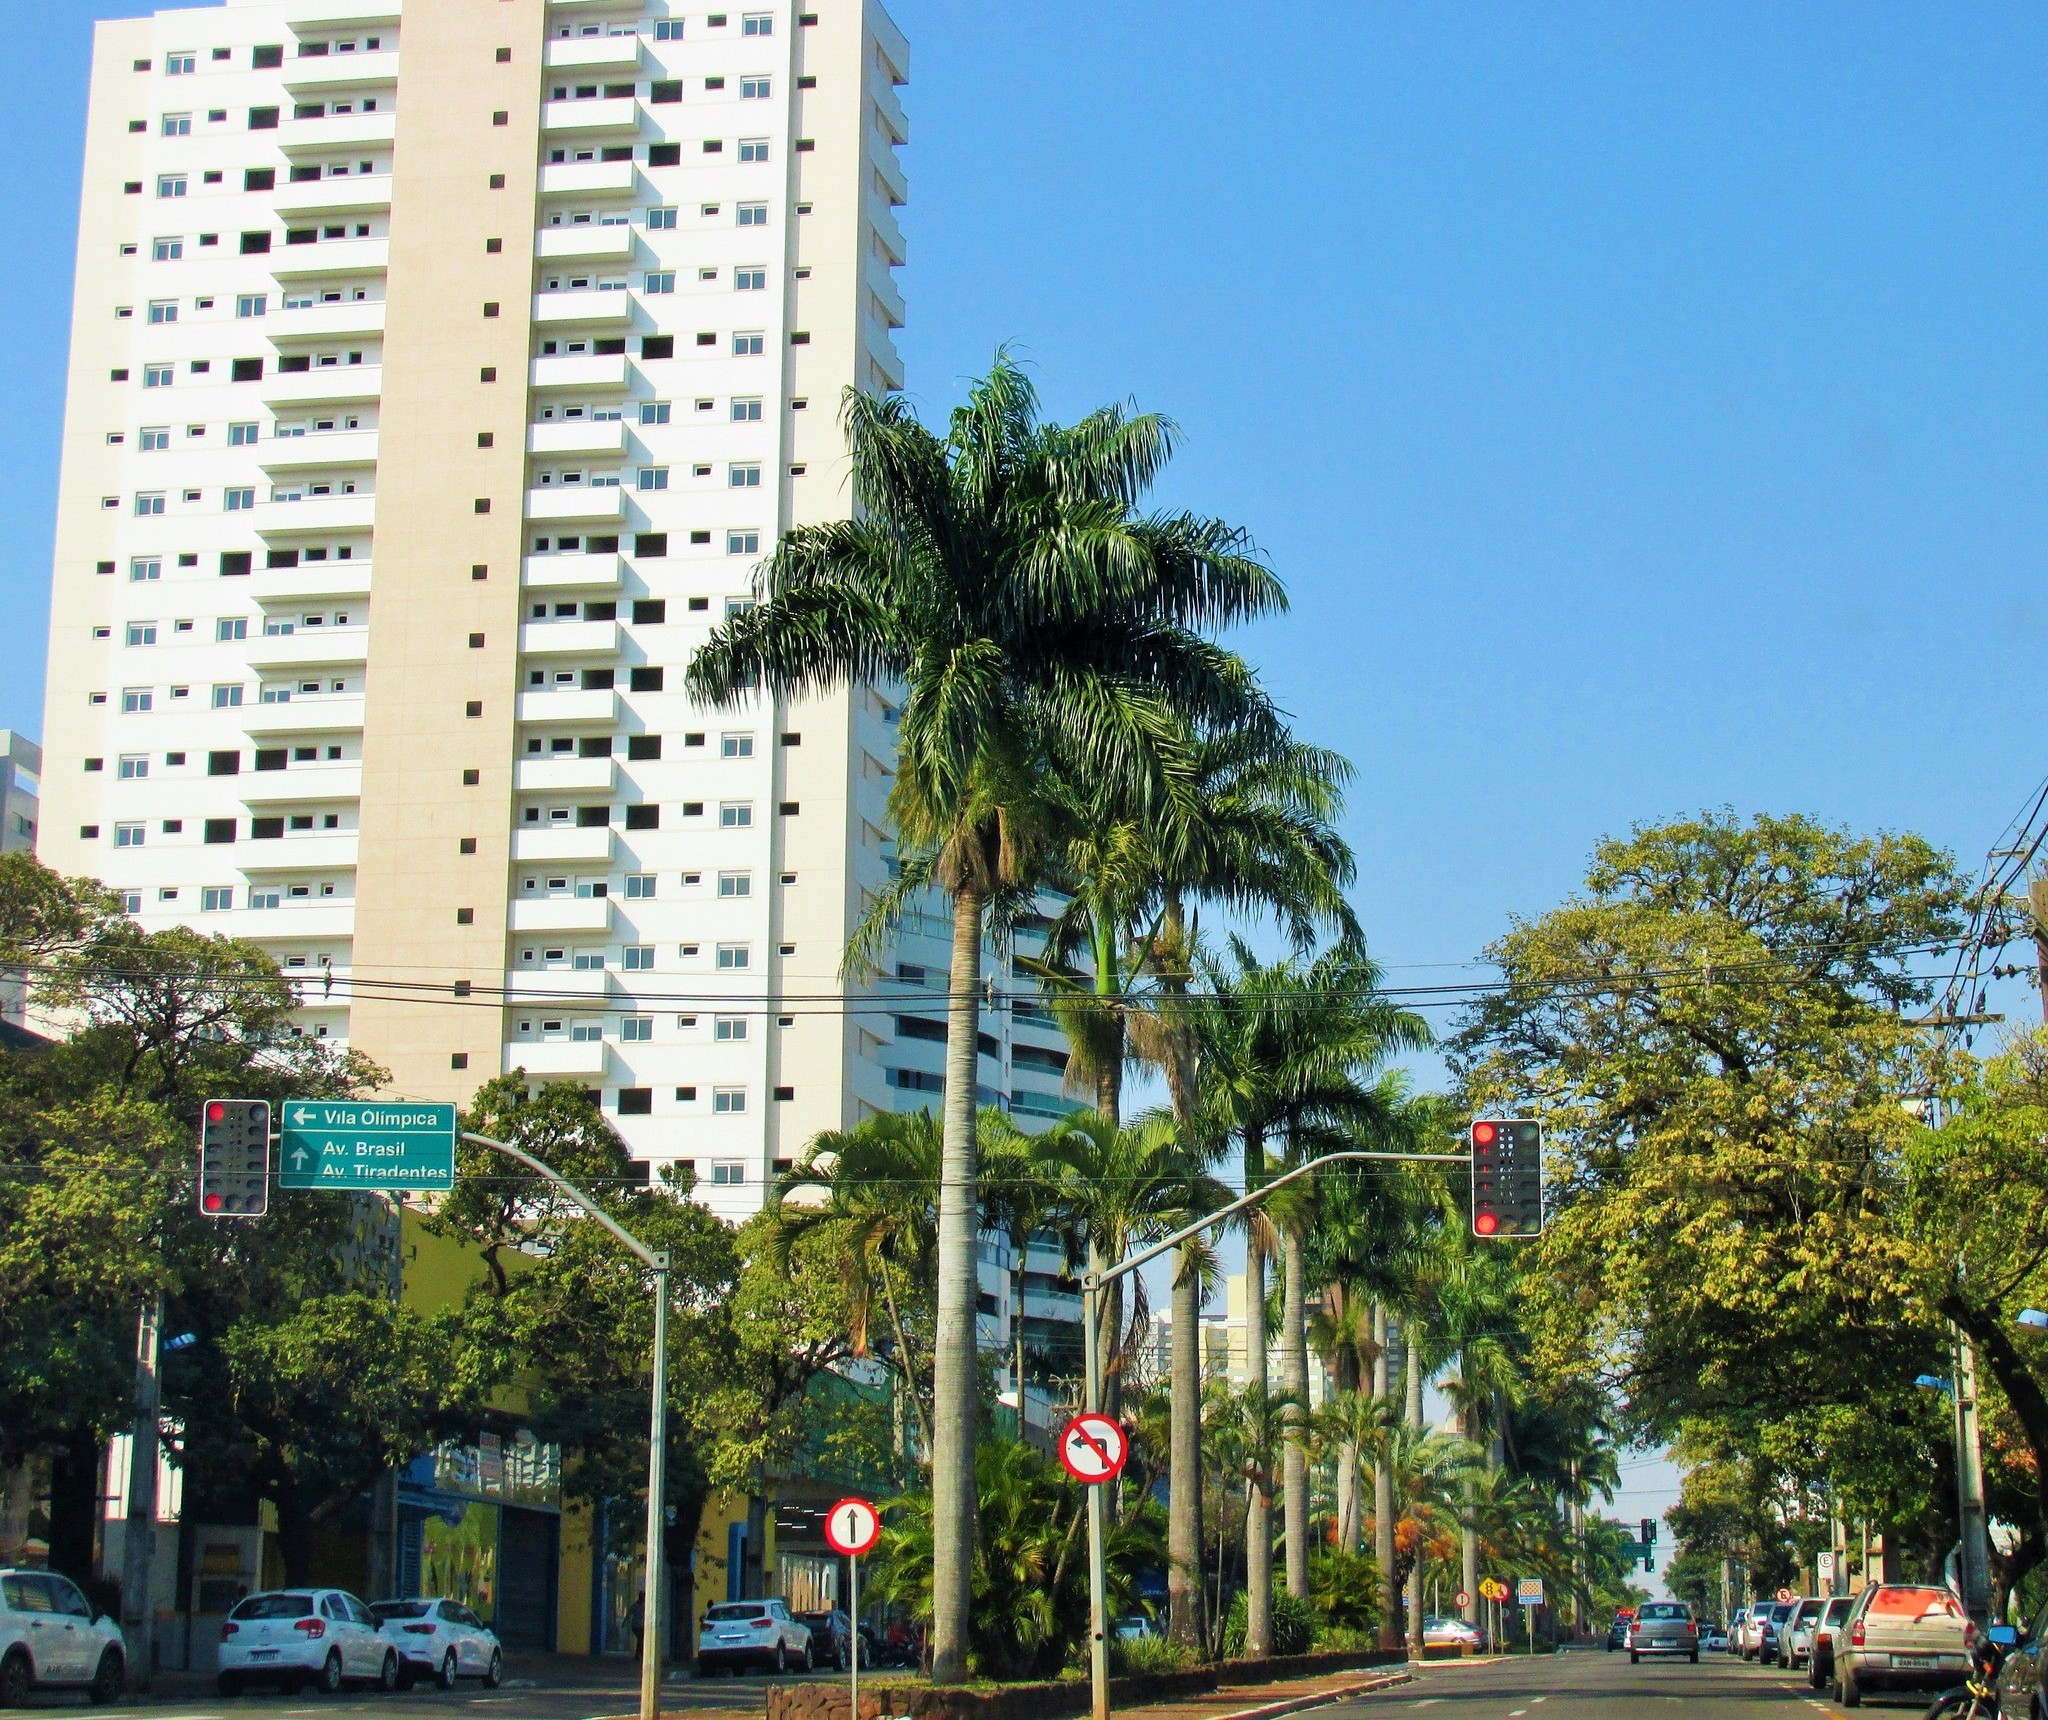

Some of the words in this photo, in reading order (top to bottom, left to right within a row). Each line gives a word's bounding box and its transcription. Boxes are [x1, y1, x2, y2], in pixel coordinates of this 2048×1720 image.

[324, 1109, 356, 1125] Vila
[322, 1141, 349, 1156] Av.
[356, 1141, 405, 1156] Brasil
[353, 1164, 448, 1180] Tiradentes
